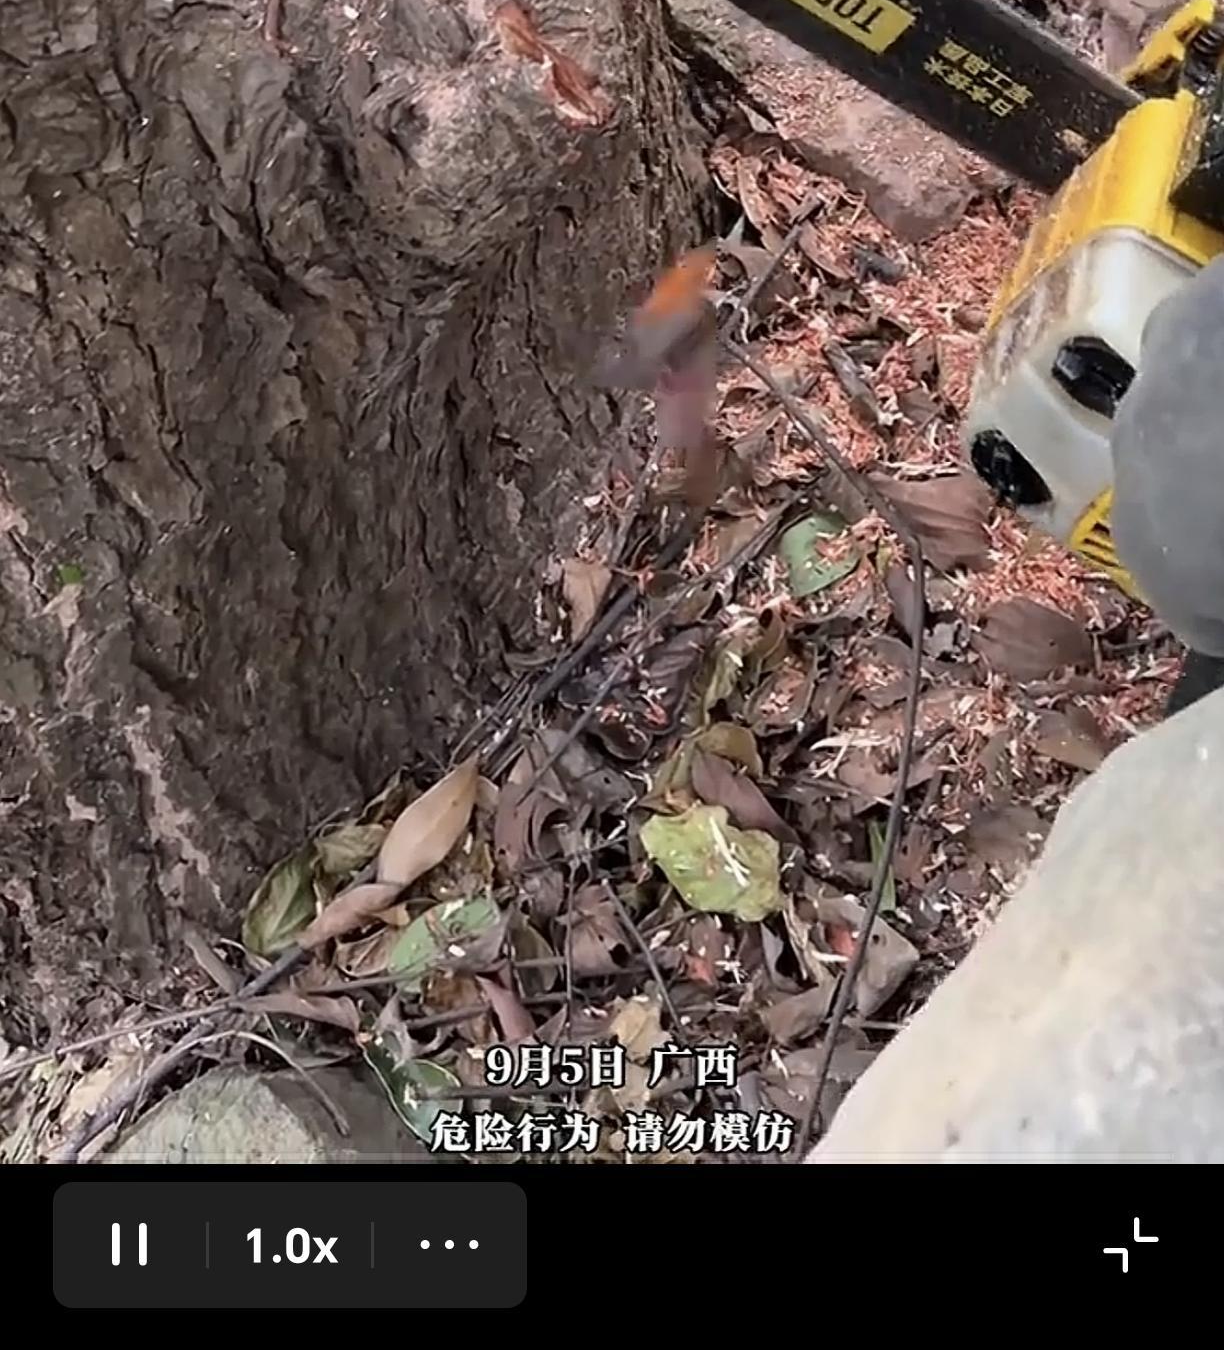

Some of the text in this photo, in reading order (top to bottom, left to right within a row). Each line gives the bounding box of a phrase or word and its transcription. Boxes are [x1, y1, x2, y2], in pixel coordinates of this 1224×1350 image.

[923, 56, 1013, 117] 日本技术
[246, 1228, 340, 1264] 1.0x
